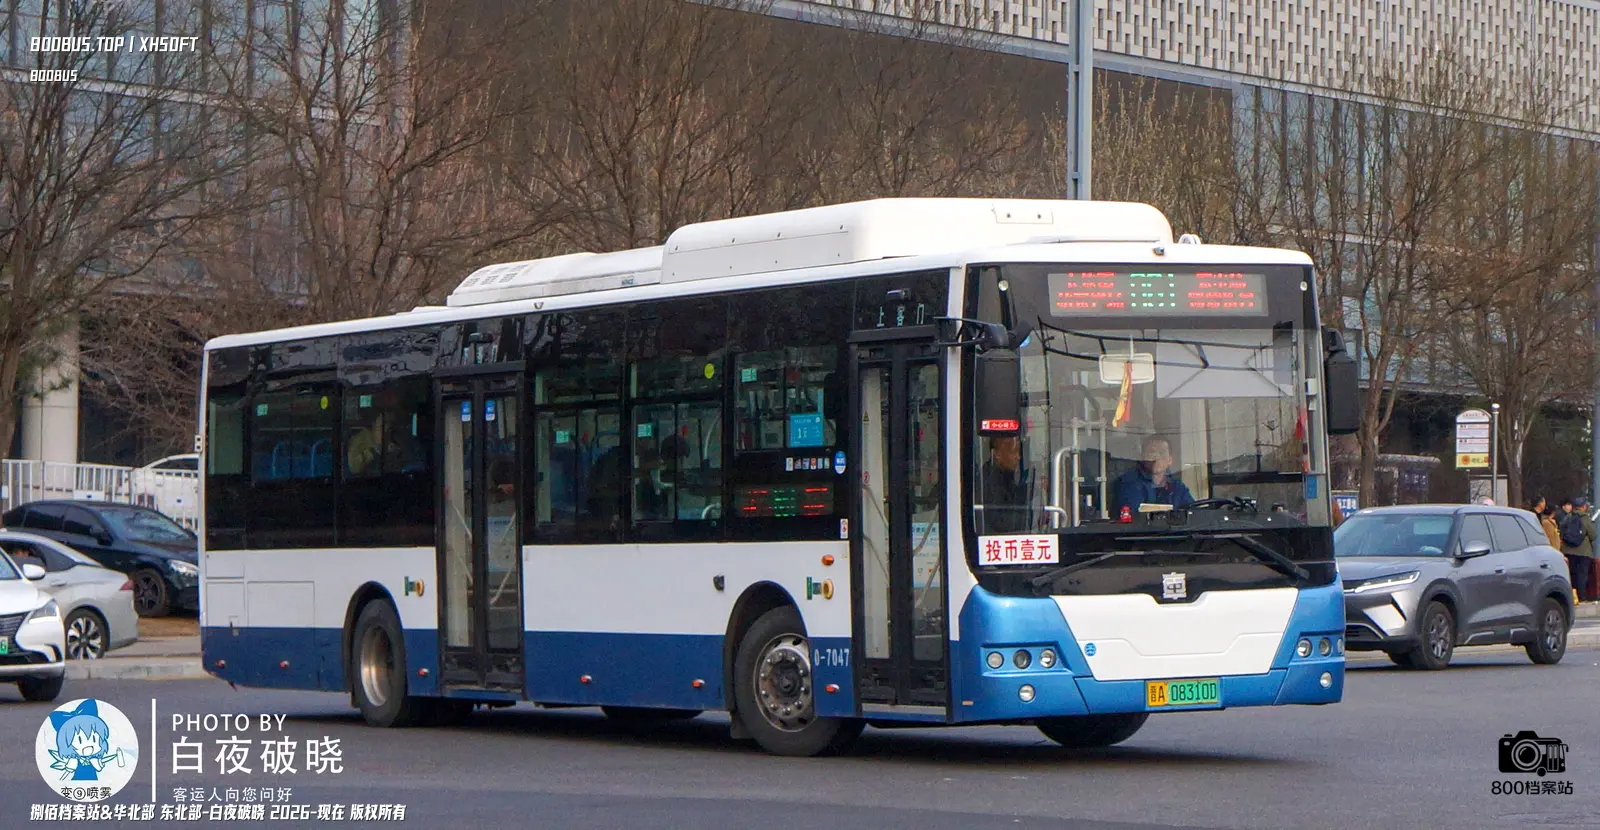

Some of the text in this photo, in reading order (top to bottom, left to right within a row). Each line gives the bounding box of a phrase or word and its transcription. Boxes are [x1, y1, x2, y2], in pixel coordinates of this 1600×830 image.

[876, 302, 925, 327] 上客门
[985, 538, 1052, 563] 投币壹元
